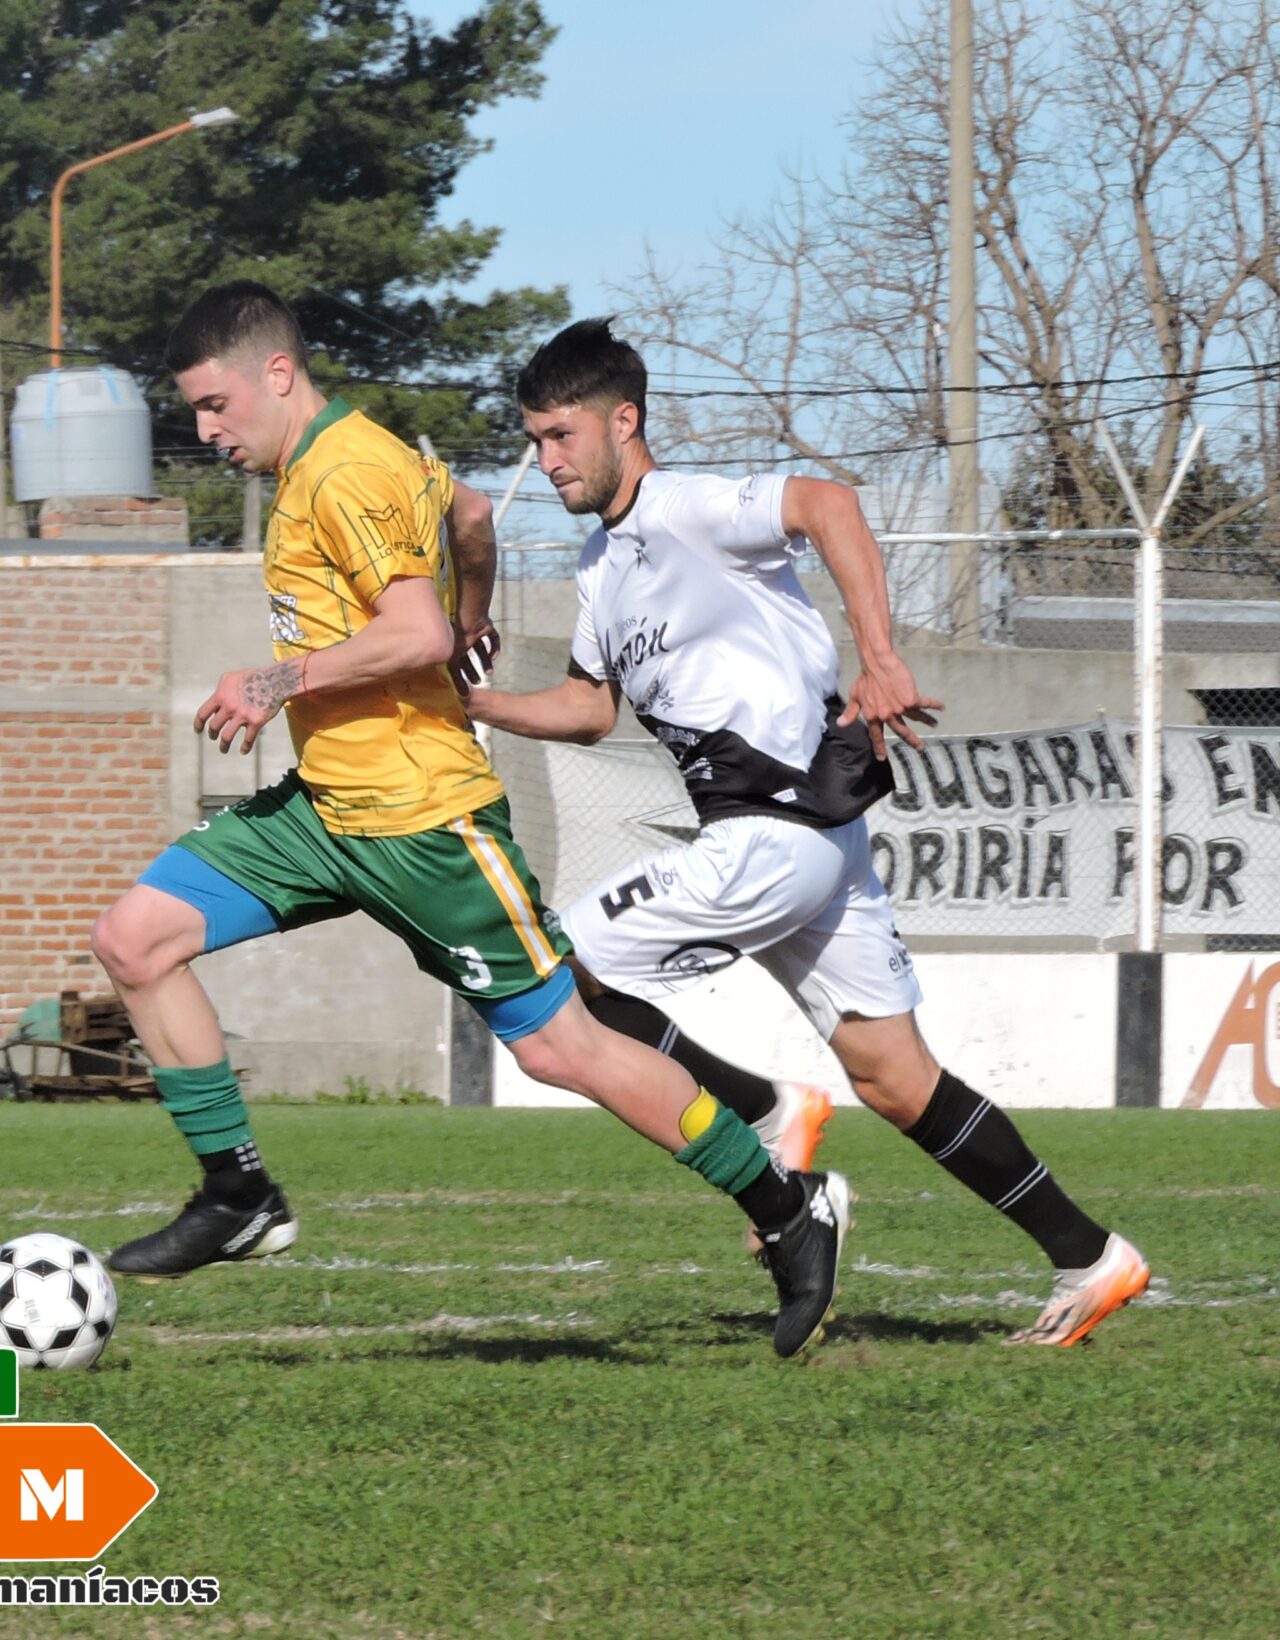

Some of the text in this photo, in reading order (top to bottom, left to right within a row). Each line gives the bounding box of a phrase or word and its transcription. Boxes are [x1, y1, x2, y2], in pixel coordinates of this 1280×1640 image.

[378, 541, 416, 560] LOSTICA
[870, 814, 1071, 902] ORIRÍA
[599, 874, 655, 922] 5
[449, 945, 493, 991] 3
